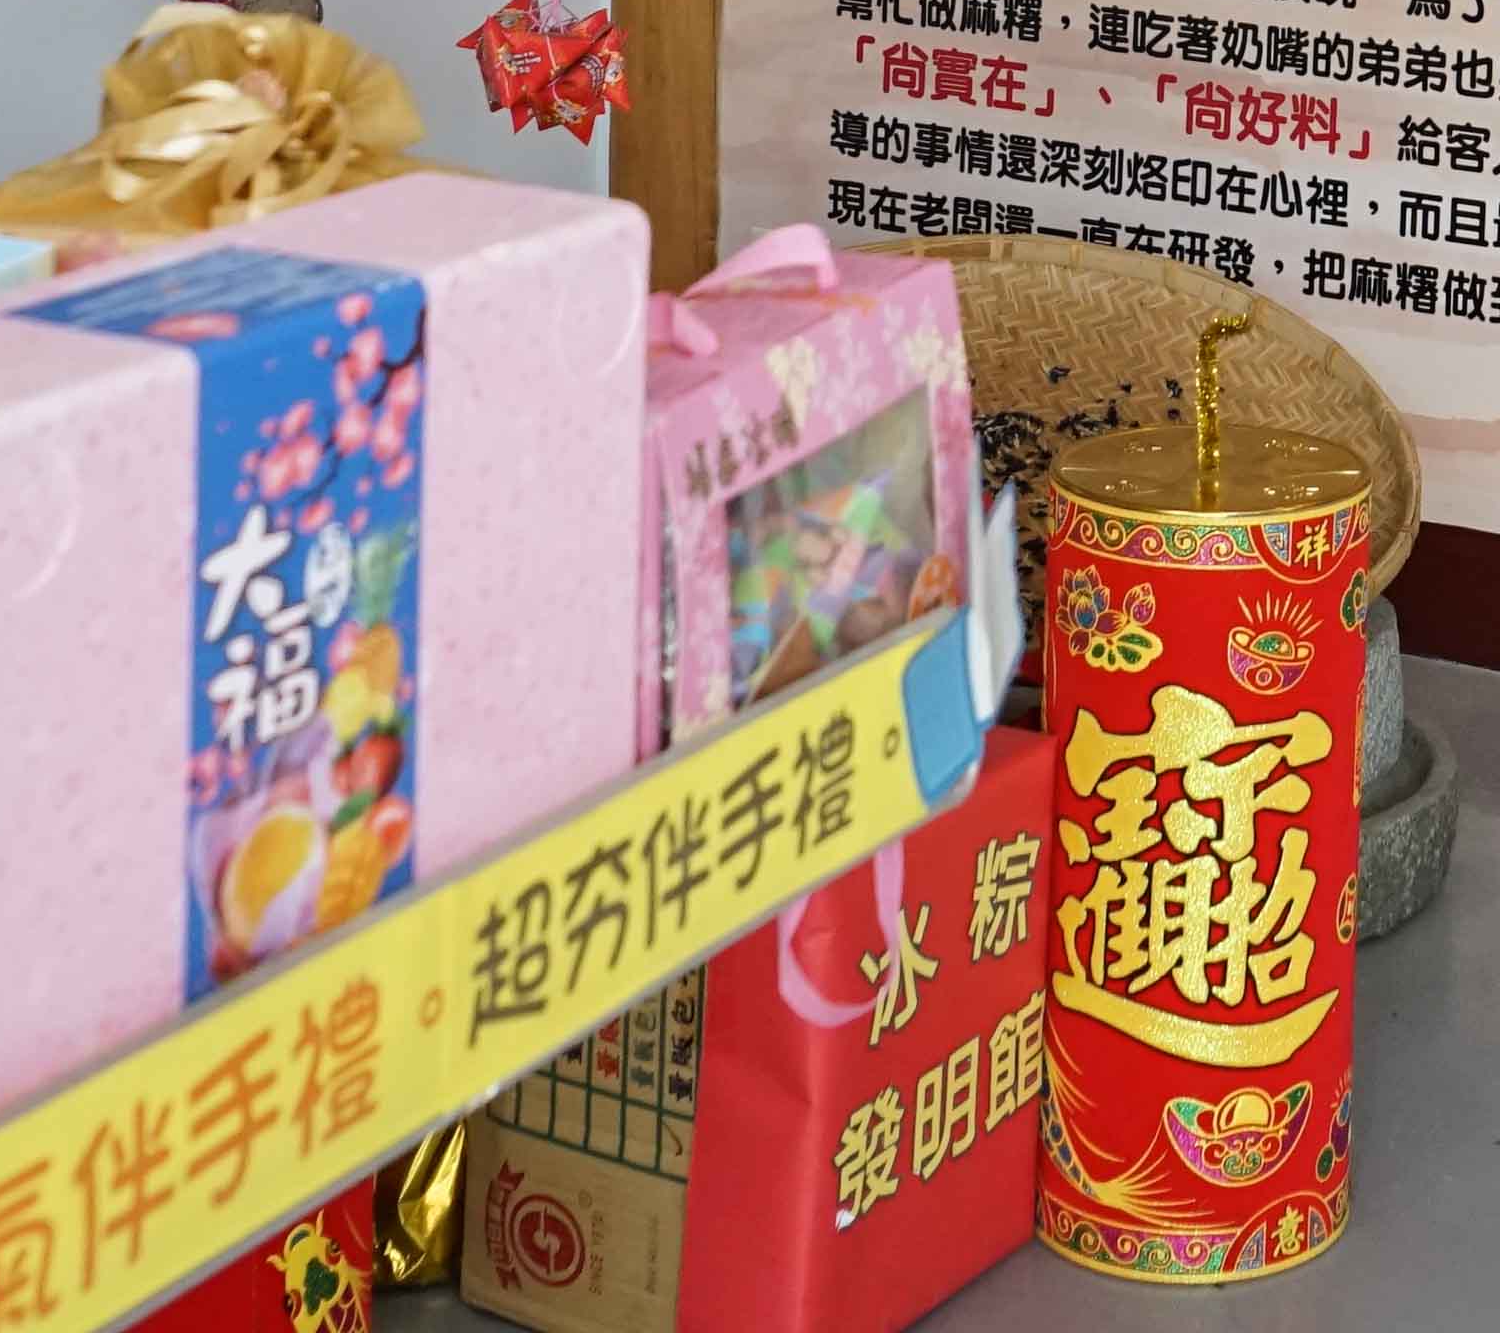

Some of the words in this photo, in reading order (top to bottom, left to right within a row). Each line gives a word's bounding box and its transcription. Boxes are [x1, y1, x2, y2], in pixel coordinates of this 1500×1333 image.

[1295, 522, 1333, 572] 祥
[199, 503, 321, 754] 大福
[833, 988, 1047, 1223] 發明館
[1271, 1205, 1304, 1259] 意
